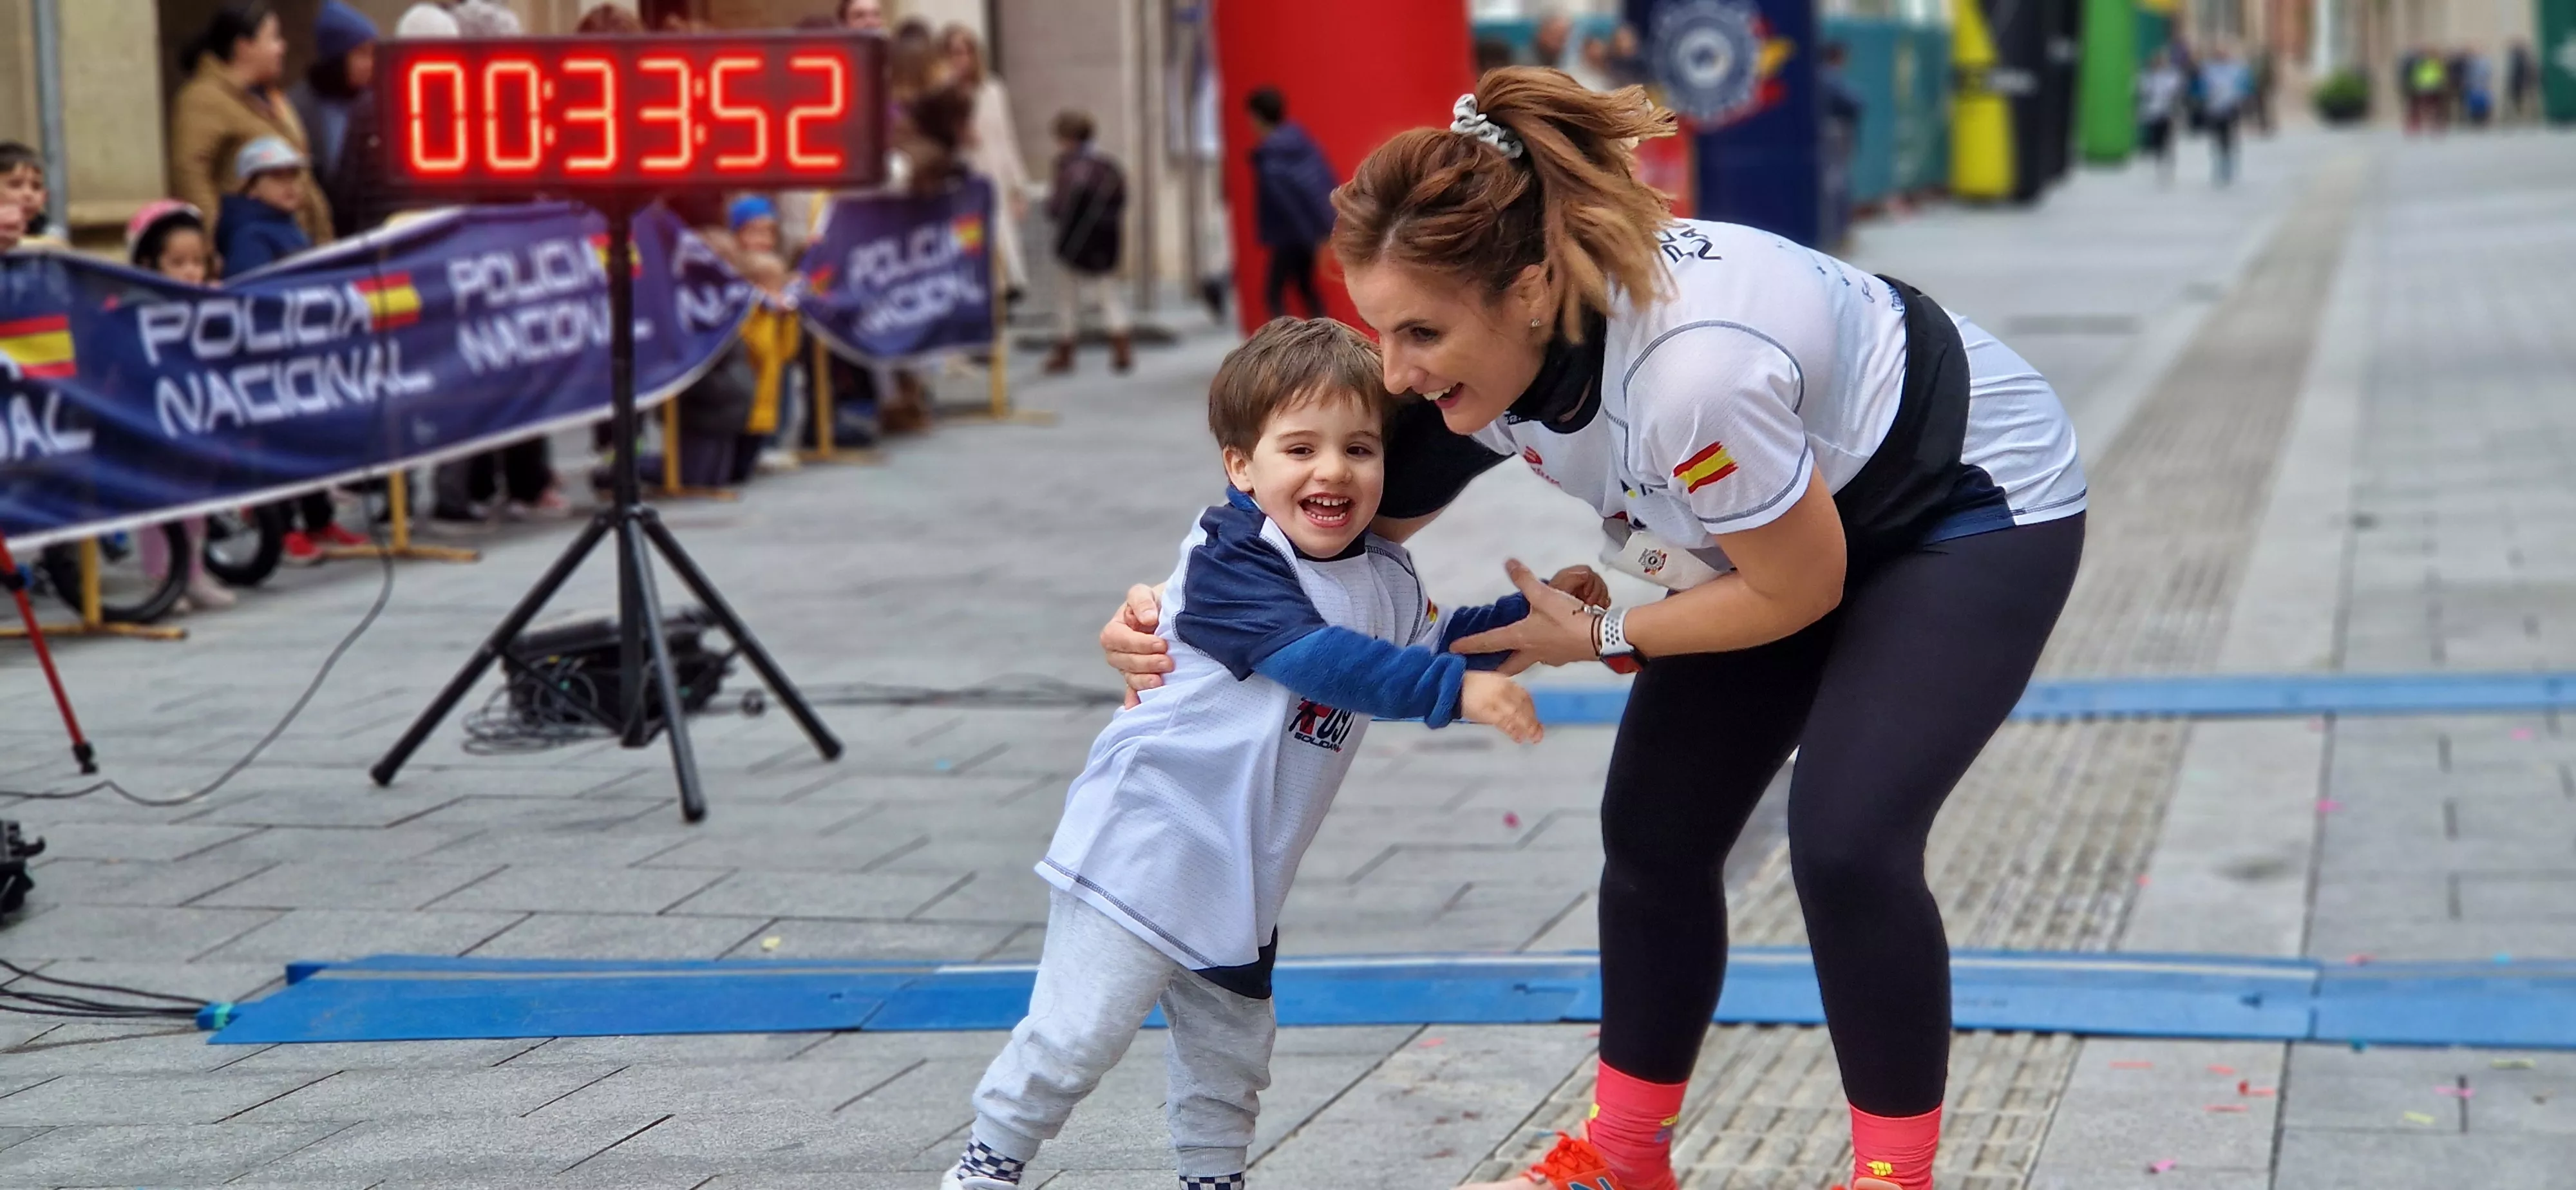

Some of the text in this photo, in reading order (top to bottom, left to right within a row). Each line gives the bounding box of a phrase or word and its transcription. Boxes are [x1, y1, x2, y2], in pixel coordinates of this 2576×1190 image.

[408, 58, 844, 171] 00:33:52
[137, 282, 374, 366] POLICIA
[459, 291, 653, 375] NACION
[155, 339, 435, 438] NACIONAL
